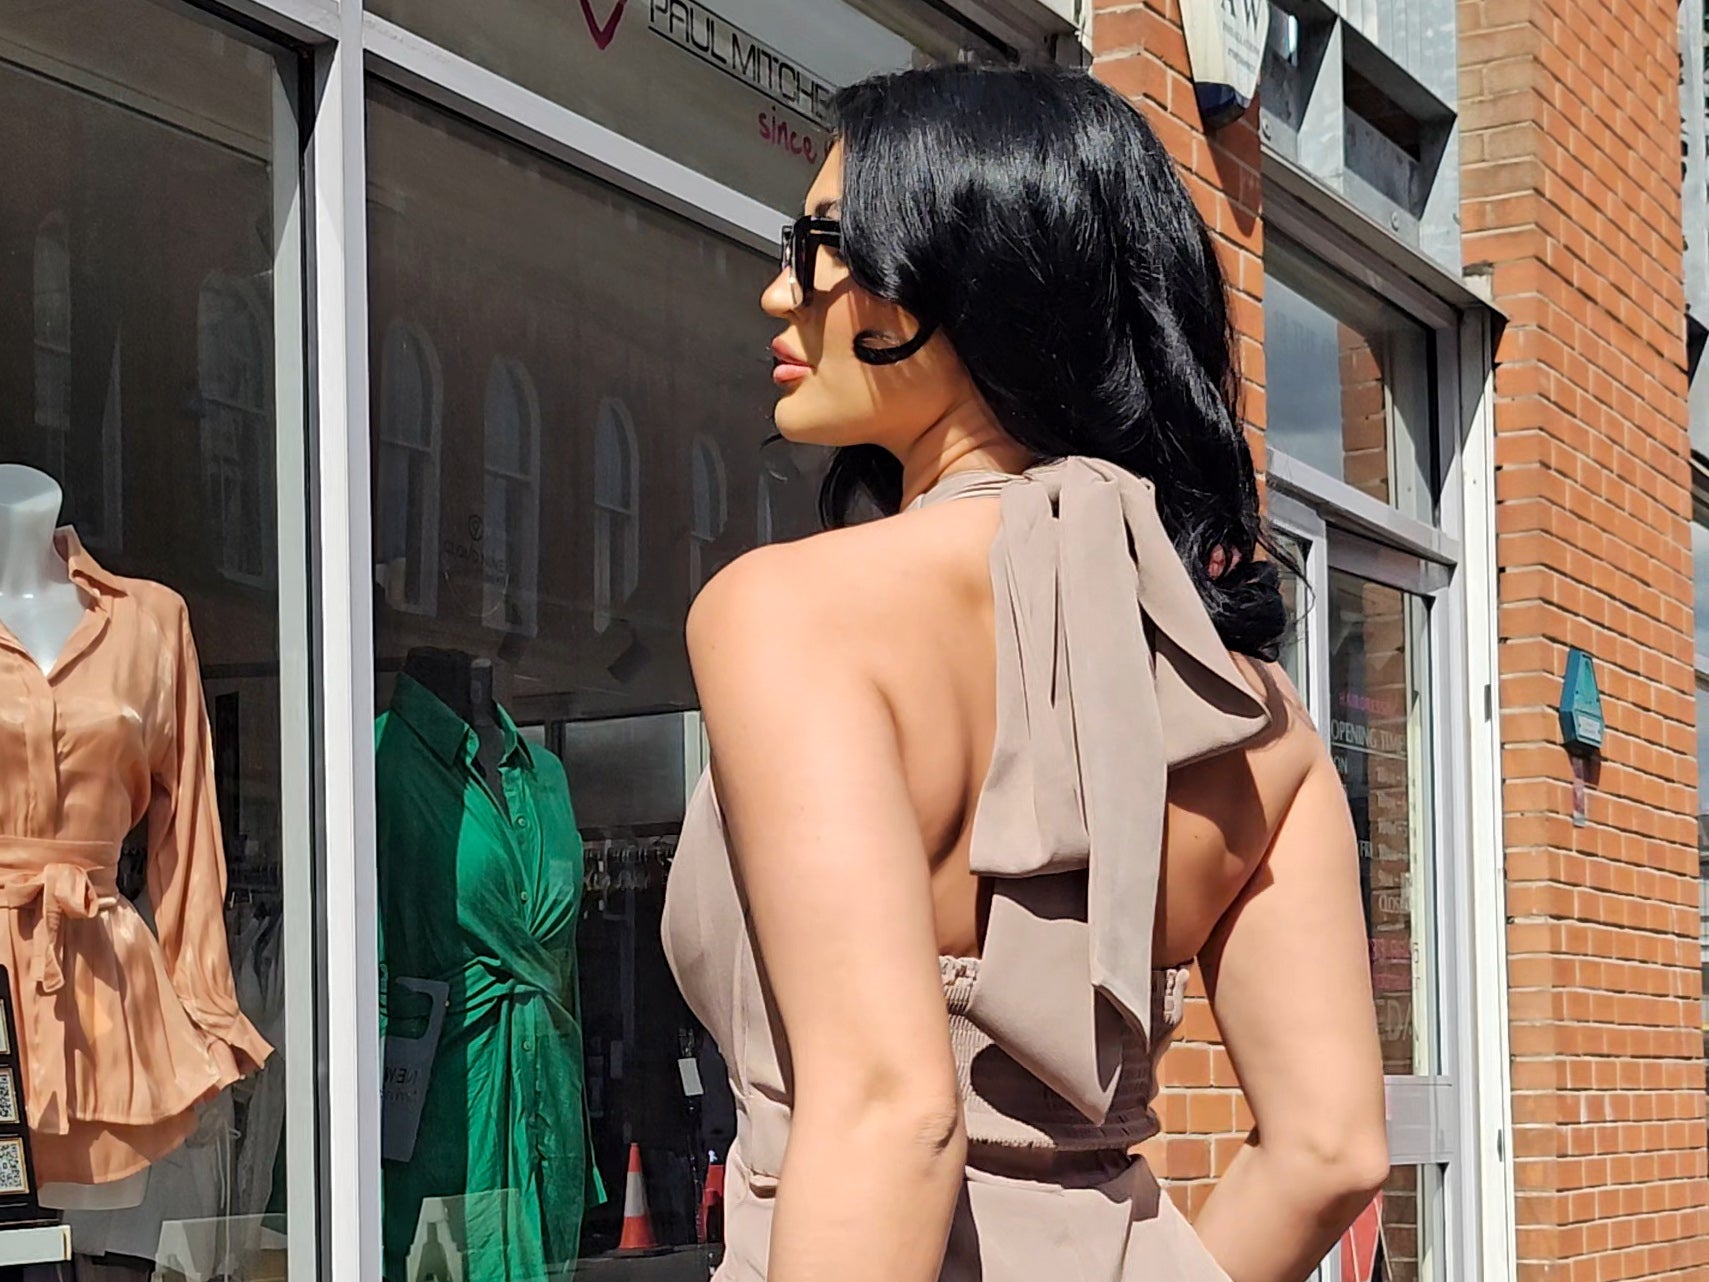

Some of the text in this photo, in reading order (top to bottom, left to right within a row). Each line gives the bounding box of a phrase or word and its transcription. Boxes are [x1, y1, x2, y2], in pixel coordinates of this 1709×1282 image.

[650, 0, 832, 118] PAUL MITCHE
[758, 106, 818, 164] since
[1330, 719, 1377, 749] OPENING
